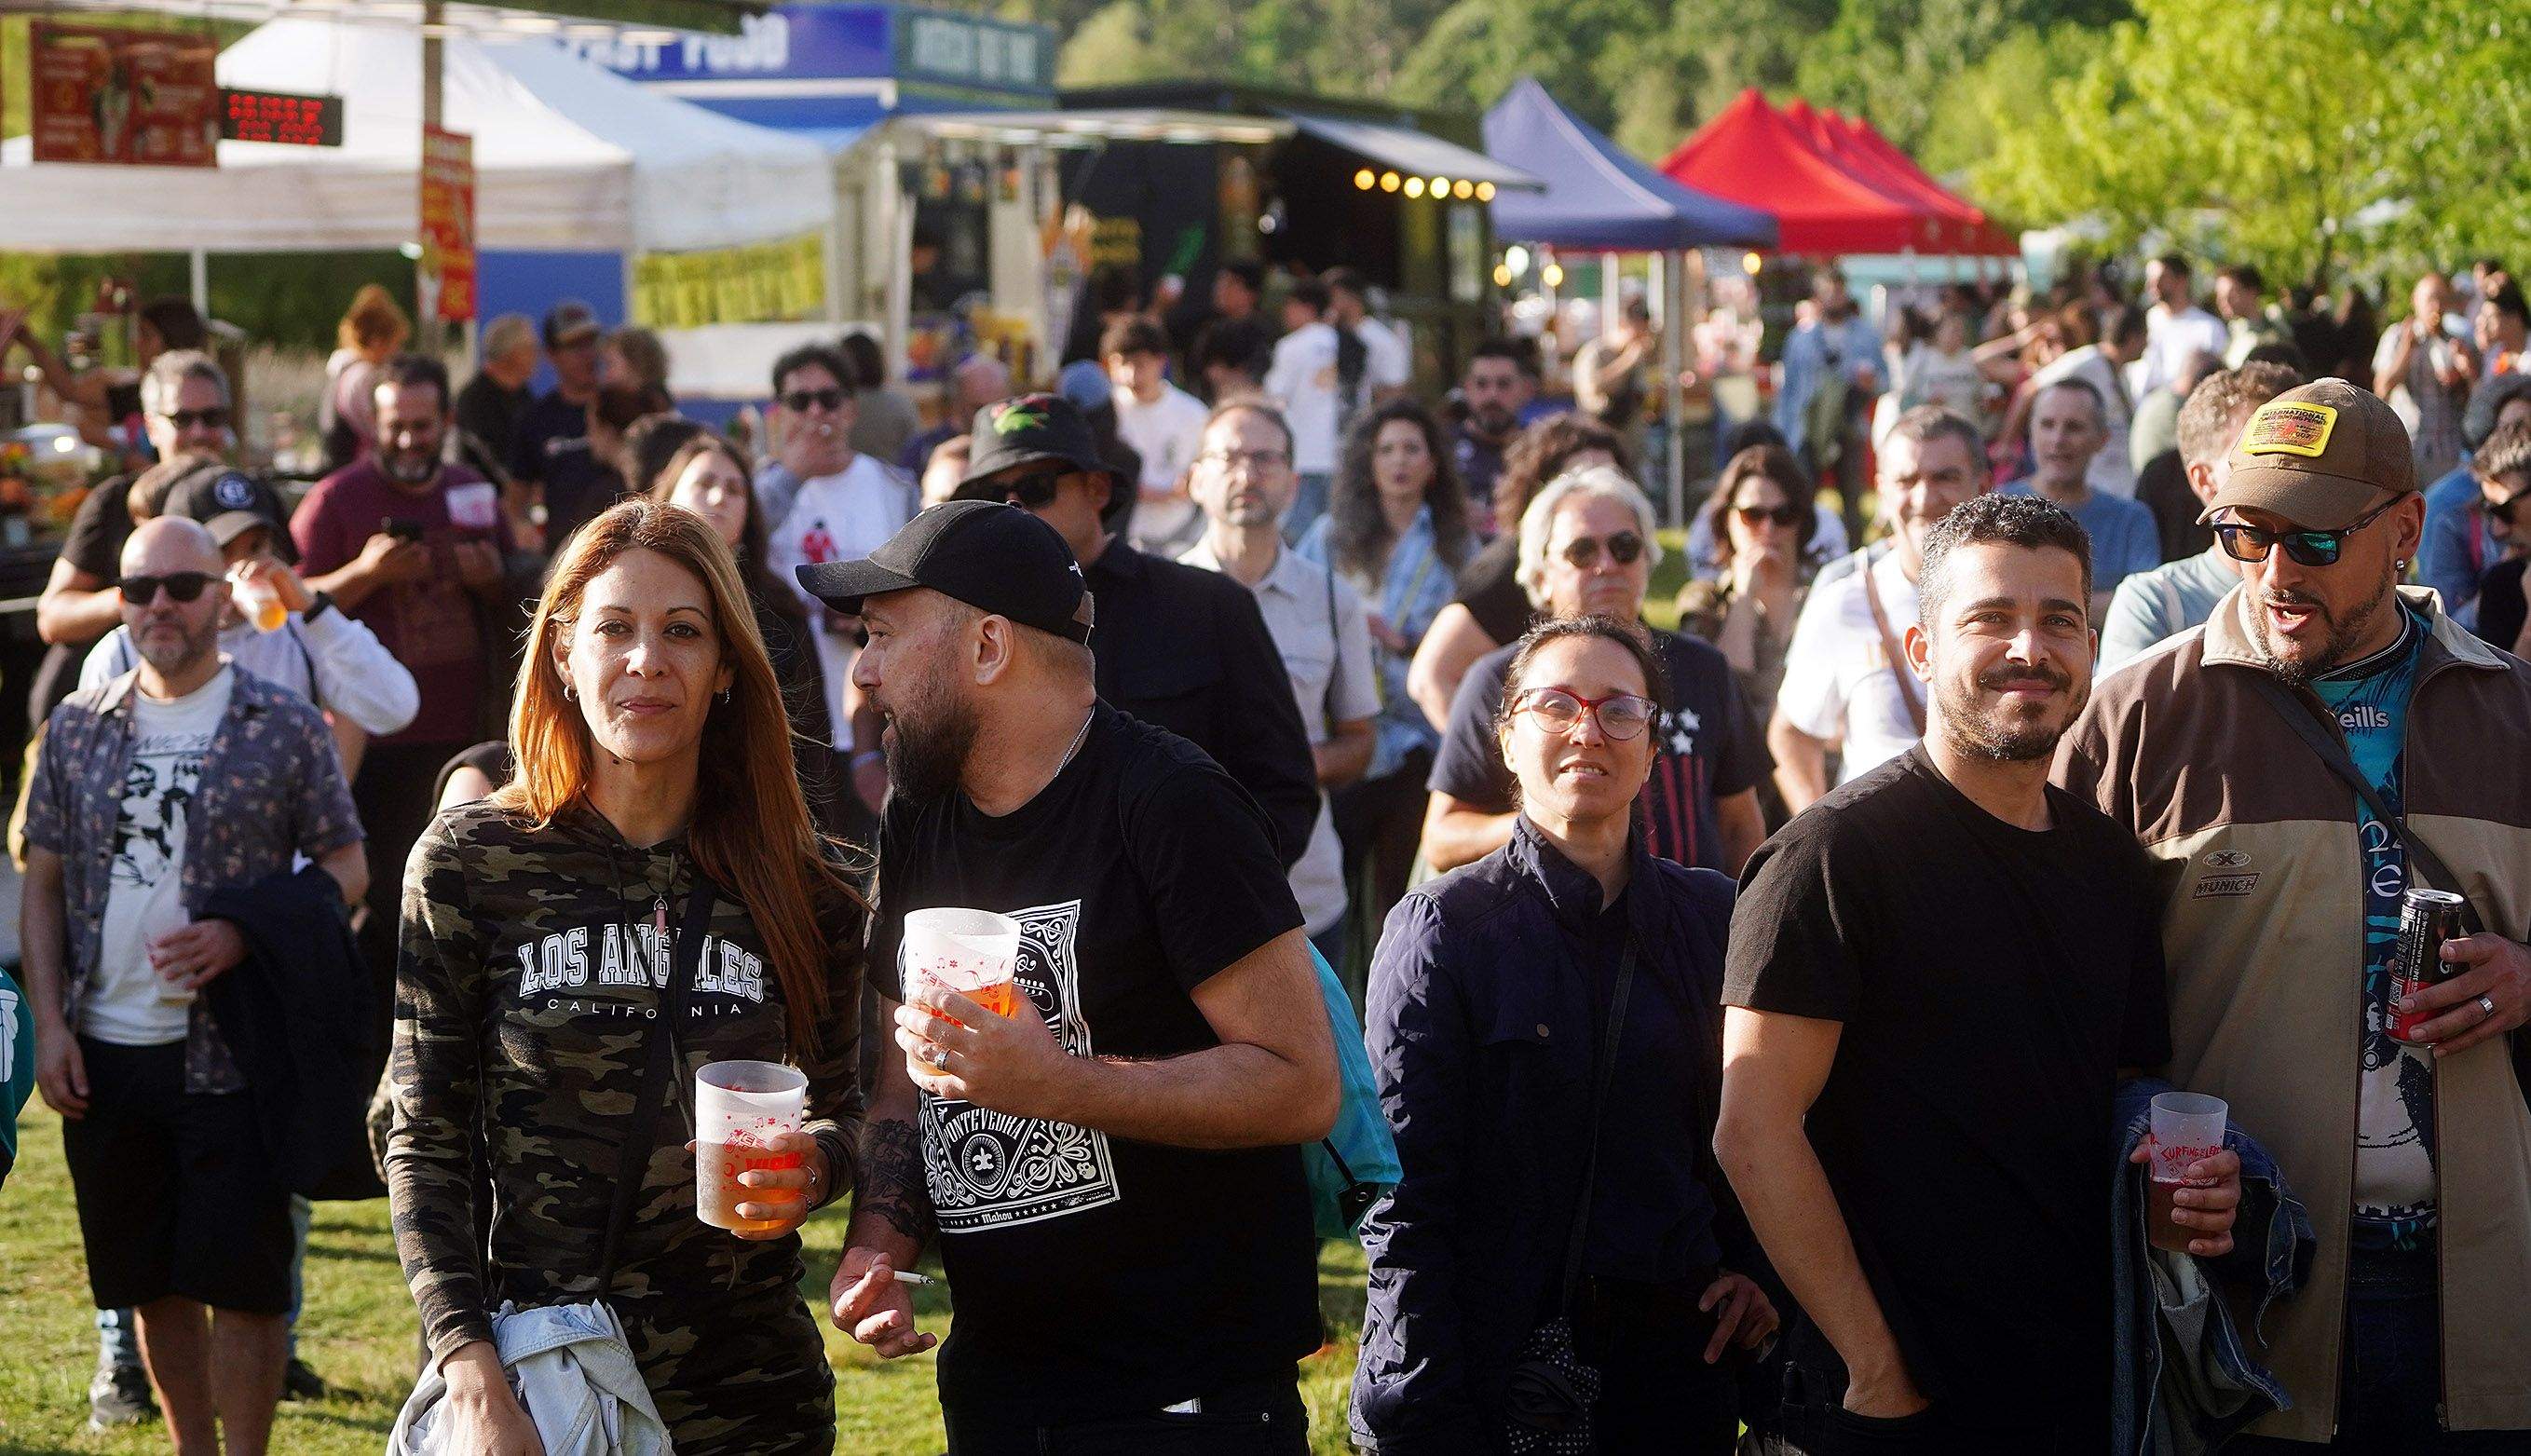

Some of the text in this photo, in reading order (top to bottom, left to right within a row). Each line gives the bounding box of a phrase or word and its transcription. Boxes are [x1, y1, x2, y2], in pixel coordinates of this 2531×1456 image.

[2339, 706, 2389, 728] eills
[2197, 879, 2255, 893] MUNICH
[518, 923, 764, 1004] LOS ANGLES
[547, 999, 742, 1019] CALIFONIA
[943, 1108, 1026, 1149] PONTEVEDRA
[981, 1212, 1014, 1224] Mahou
